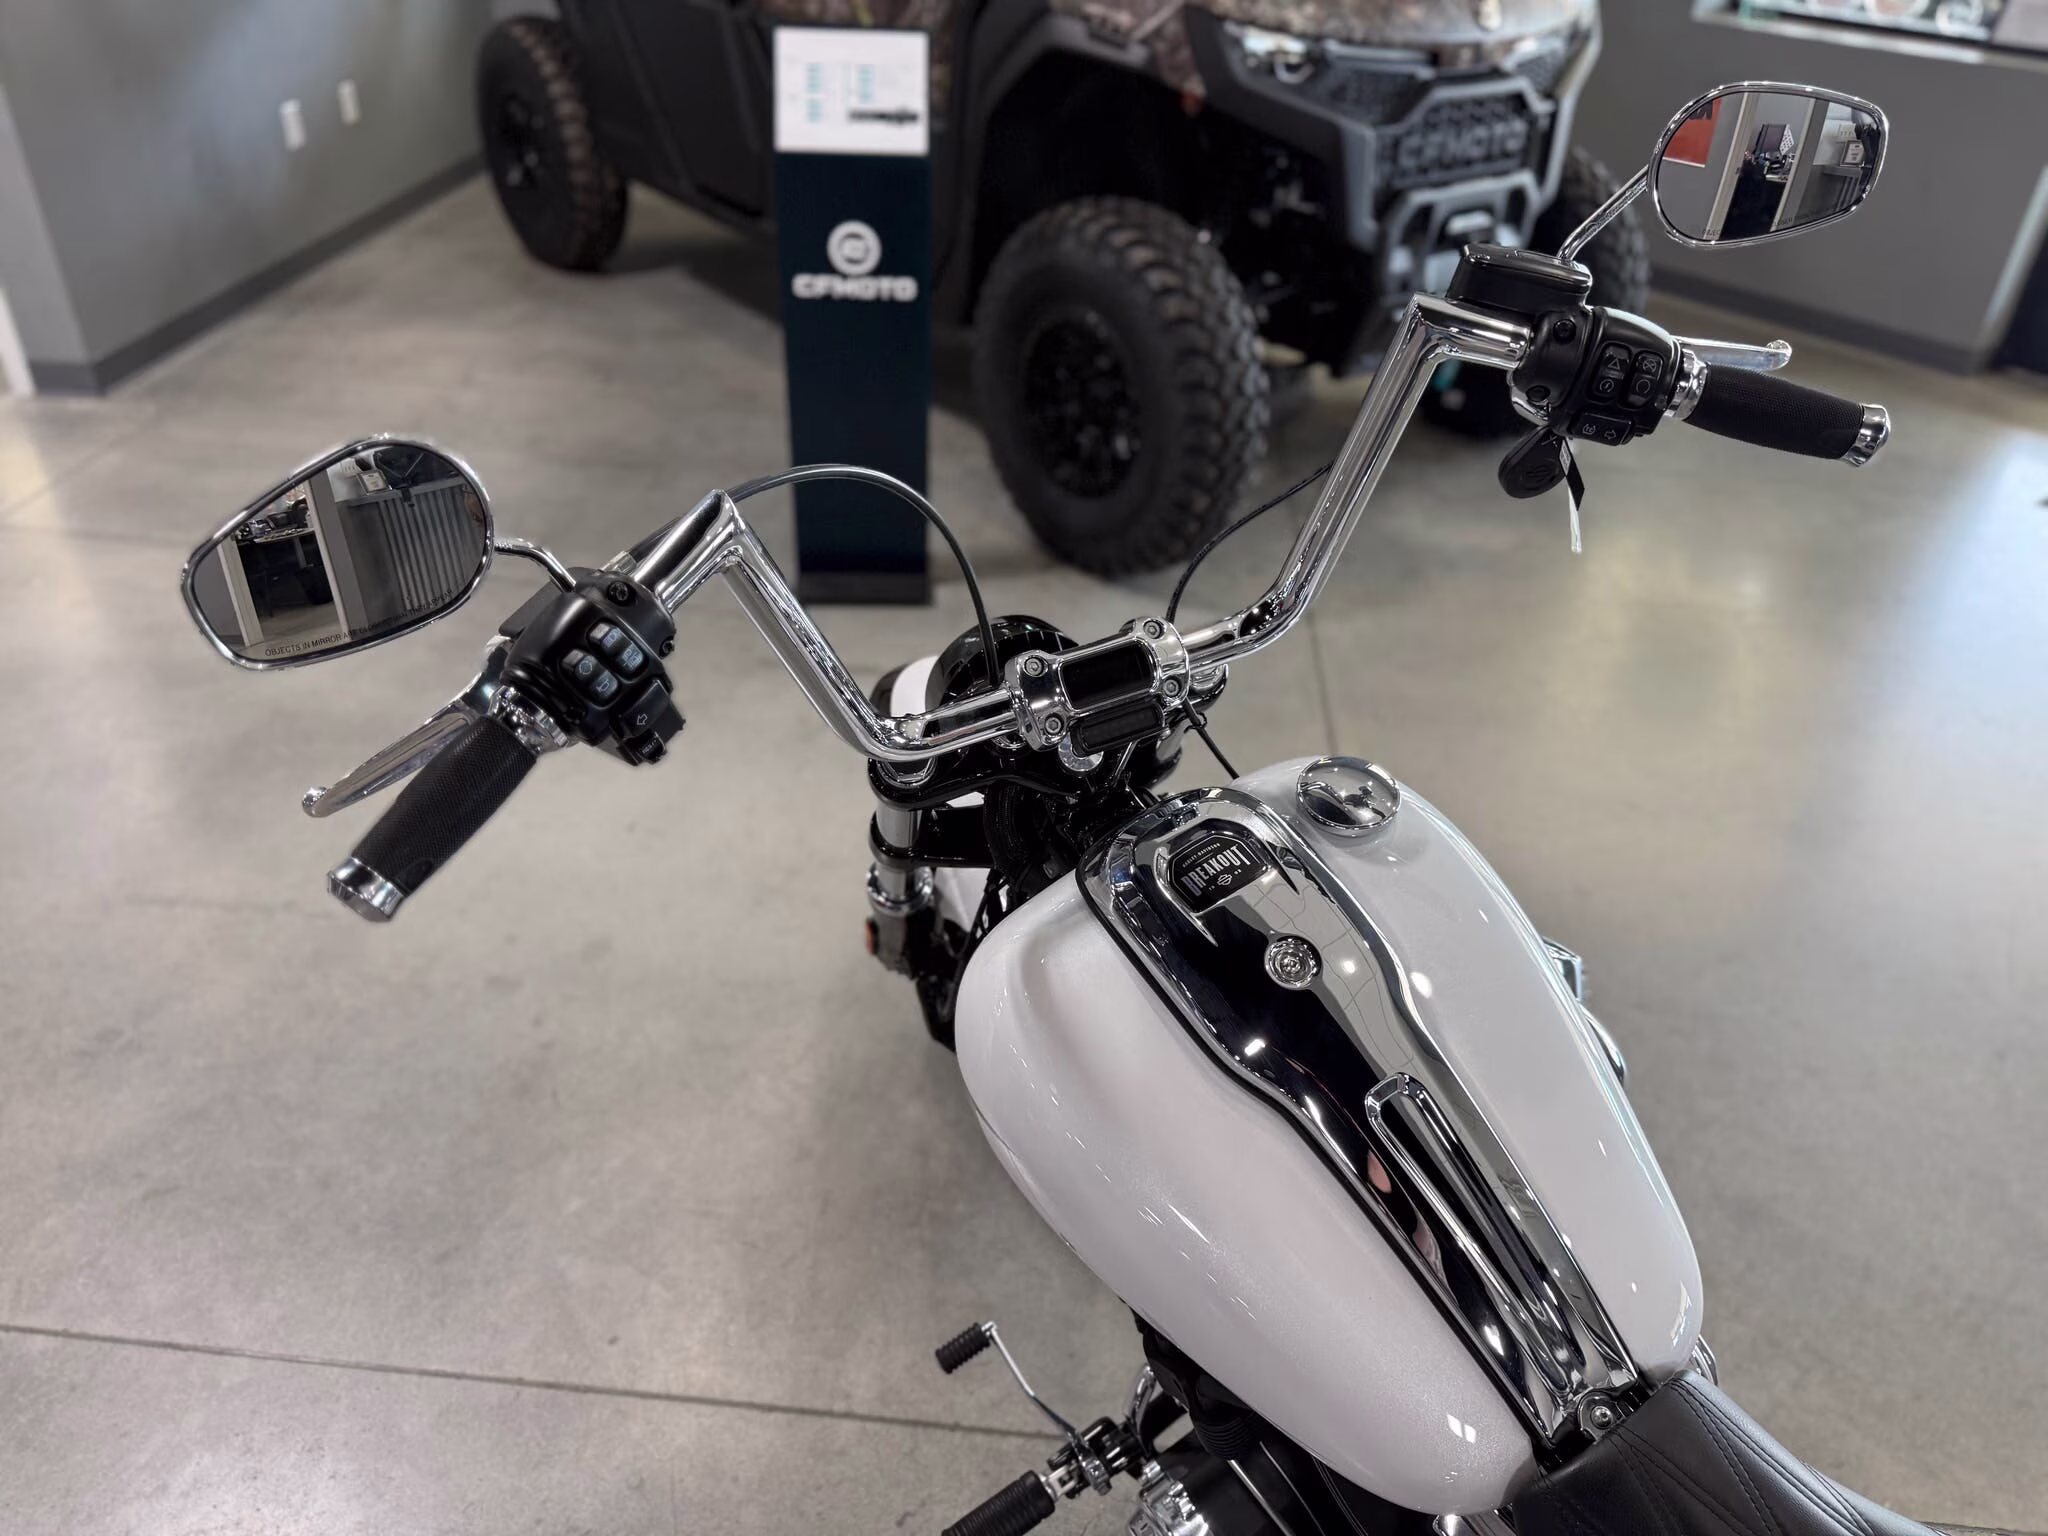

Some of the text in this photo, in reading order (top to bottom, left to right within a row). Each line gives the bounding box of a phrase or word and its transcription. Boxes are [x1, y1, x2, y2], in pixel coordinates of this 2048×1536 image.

[791, 273, 918, 302] CFMOTO
[264, 643, 301, 657] OBJECTS
[311, 633, 342, 648] MIRROR
[1180, 845, 1251, 897] BREAKOUT
